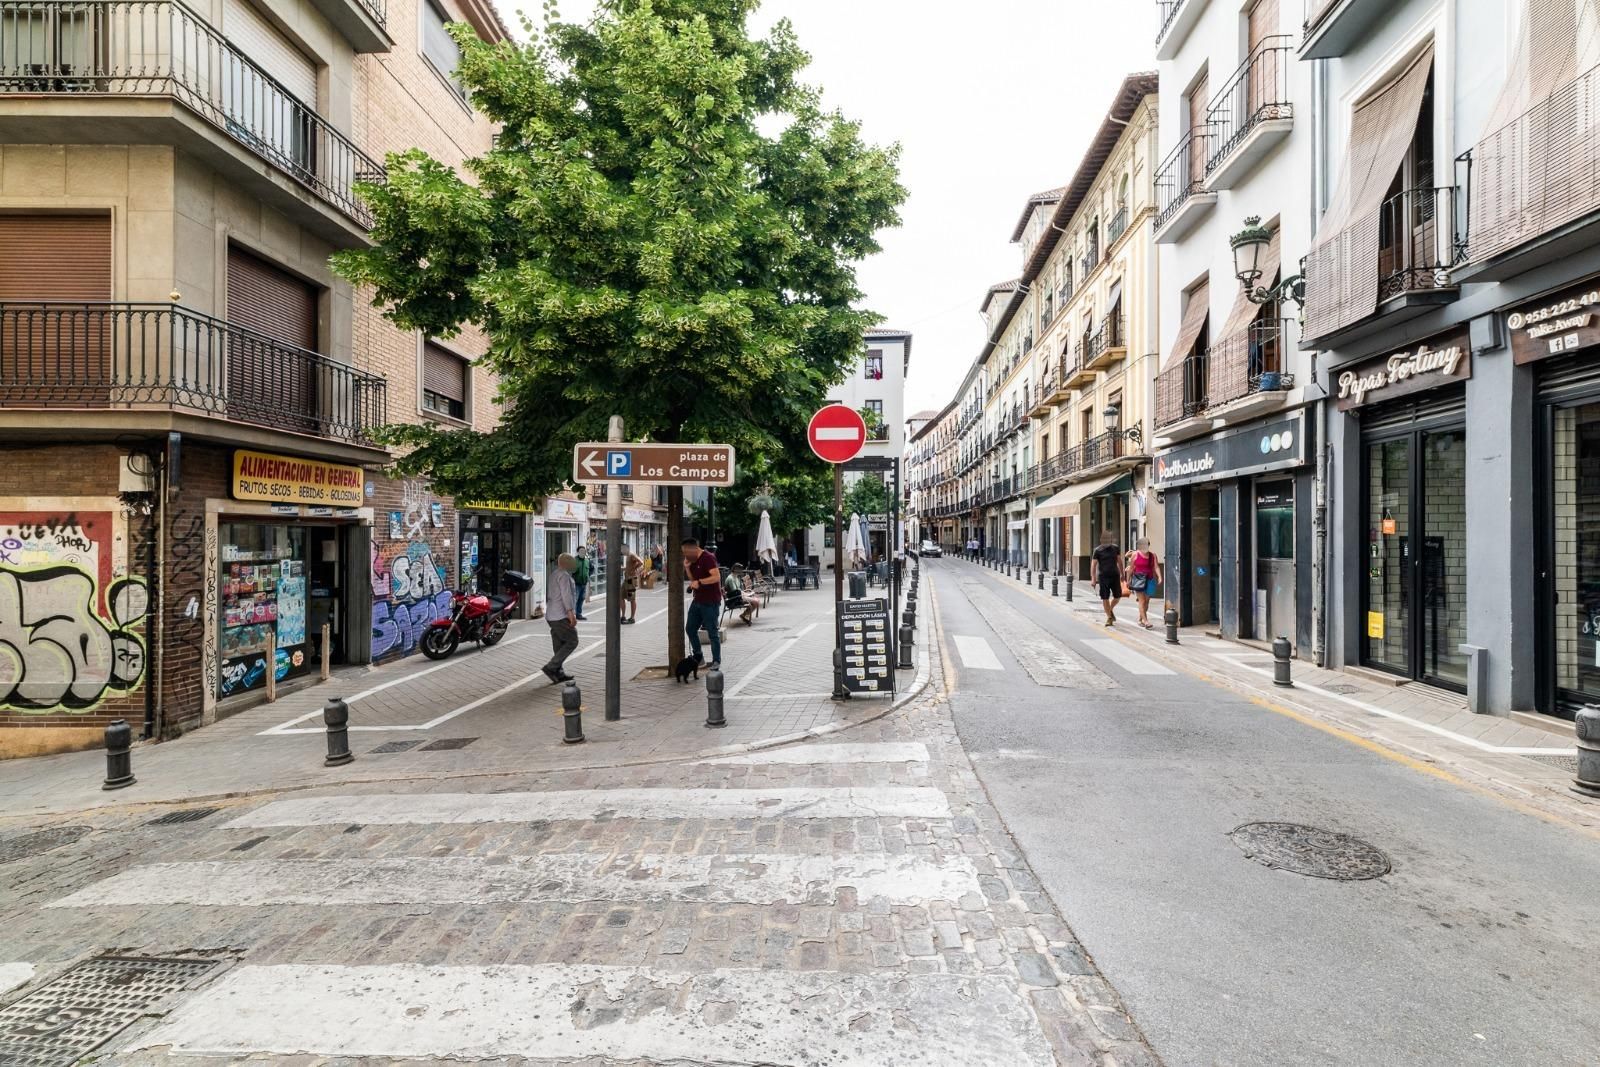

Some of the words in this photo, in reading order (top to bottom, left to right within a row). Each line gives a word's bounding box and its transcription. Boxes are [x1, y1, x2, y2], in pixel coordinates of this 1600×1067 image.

[1525, 307, 1548, 324] 958
[1551, 299, 1578, 316] 222
[1580, 290, 1600, 306] 40
[1527, 323, 1554, 339] Take
[1554, 313, 1588, 331] Away
[1338, 371, 1387, 404] Papas
[1387, 345, 1462, 384] Fortuny
[611, 453, 628, 474] P
[640, 465, 663, 477] Los
[669, 465, 726, 479] Campos
[680, 452, 709, 462] plaza
[713, 452, 726, 461] de
[240, 456, 312, 483] ALIMENTACION
[315, 465, 326, 484] EN
[328, 468, 361, 488] GENERAL
[240, 480, 268, 495] FRUTOS
[270, 483, 291, 497] SECOS
[299, 486, 323, 499] BEBIDAS
[331, 489, 361, 501] GOLOSINAS
